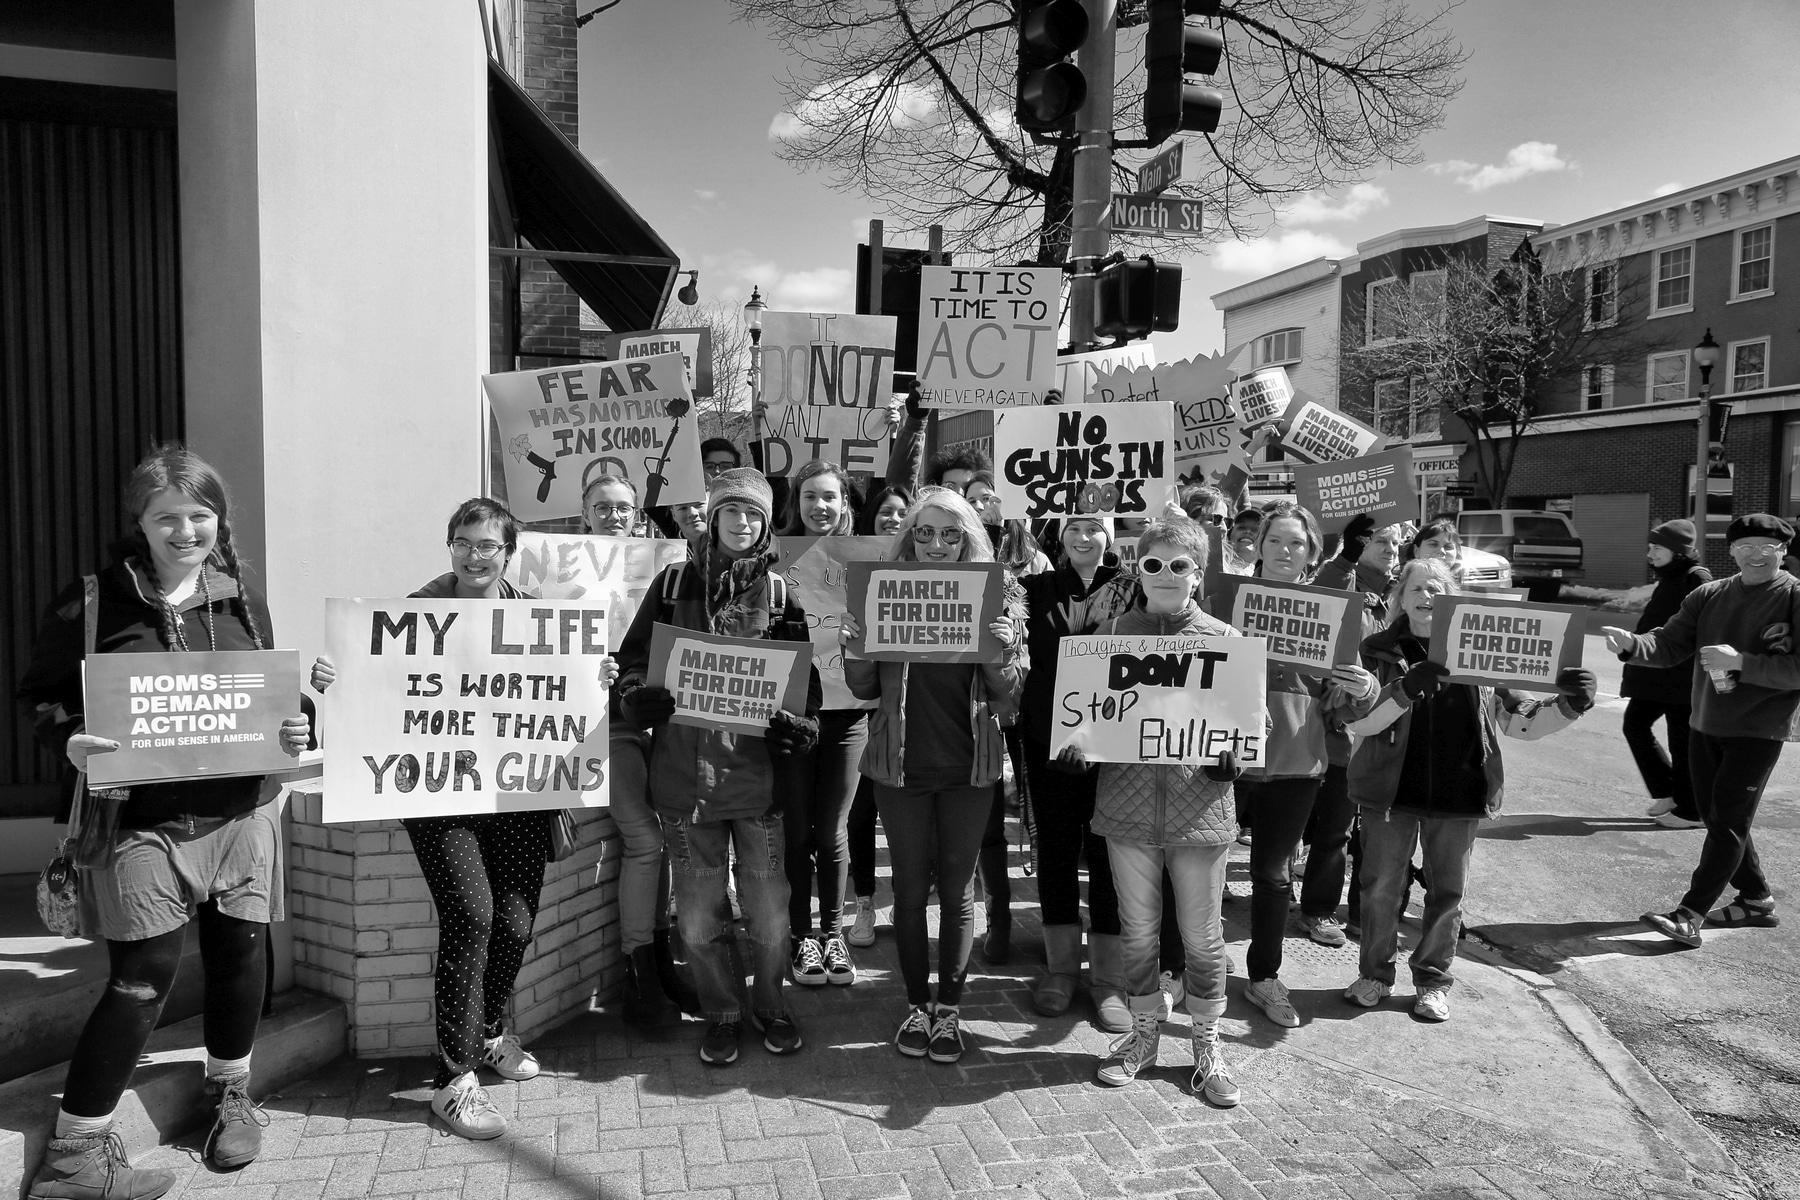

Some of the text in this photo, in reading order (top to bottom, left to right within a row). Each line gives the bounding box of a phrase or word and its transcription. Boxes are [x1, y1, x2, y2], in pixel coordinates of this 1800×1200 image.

[1141, 151, 1179, 192] Main St
[1114, 198, 1200, 231] North St
[950, 270, 1035, 296] IT IS
[930, 297, 1048, 321] TIME TO
[810, 313, 837, 347] I
[626, 341, 681, 359] MARCH
[921, 321, 1052, 382] ACT
[536, 362, 658, 403] FEAR
[761, 345, 896, 408] DO NOT
[1239, 378, 1278, 399] MARCH
[920, 388, 1044, 406] #NEVERAGAIN
[1239, 388, 1287, 411] FOR OUR
[528, 398, 671, 428] HAS NO PLACE
[763, 404, 830, 438] WANT
[1243, 403, 1279, 424] LIVES
[1305, 408, 1359, 443] MARCH
[552, 426, 663, 458] IN SCHOOL
[1056, 410, 1107, 447] NO
[1299, 419, 1360, 459] FOR OUR
[763, 436, 879, 478] DIE
[1292, 431, 1334, 462] LIVES
[1004, 440, 1165, 486] GUNS IN
[1418, 459, 1459, 472] OFFICES
[1317, 469, 1368, 488] MOMS
[1319, 478, 1388, 499] DEMAND
[1025, 479, 1147, 518] SCHOOLS
[1321, 492, 1380, 511] ACTION
[1334, 510, 1347, 518] GUN
[1348, 508, 1366, 516] SENSE
[1372, 501, 1397, 512] AMERICA
[878, 580, 959, 600] MARCH
[878, 602, 973, 622] FOR OUR
[1244, 592, 1320, 619] MARCH
[370, 611, 459, 655] MY
[491, 608, 605, 655] LIFE
[878, 625, 940, 644] LIVES
[1243, 611, 1331, 642] FOR OUR
[1460, 613, 1542, 636] MARCH
[1063, 638, 1206, 660] Thoughts & Prayers
[1459, 632, 1553, 657] FOR OUR
[680, 648, 766, 677] MARCH
[1108, 651, 1228, 690] DON'T
[1457, 652, 1519, 673] LIVES
[130, 673, 218, 693] MOMS
[406, 673, 567, 701] IS WORTH
[678, 670, 778, 700] FOR OUR
[130, 692, 251, 714] DEMAND
[676, 691, 742, 717] LIVES
[130, 713, 237, 735] ACTION
[403, 709, 587, 743] MORE THAN
[131, 732, 265, 749] FOR GUN SENSE IN AMERICA
[1139, 718, 1260, 761] Bullets
[362, 750, 605, 794] YOUR GUNS
